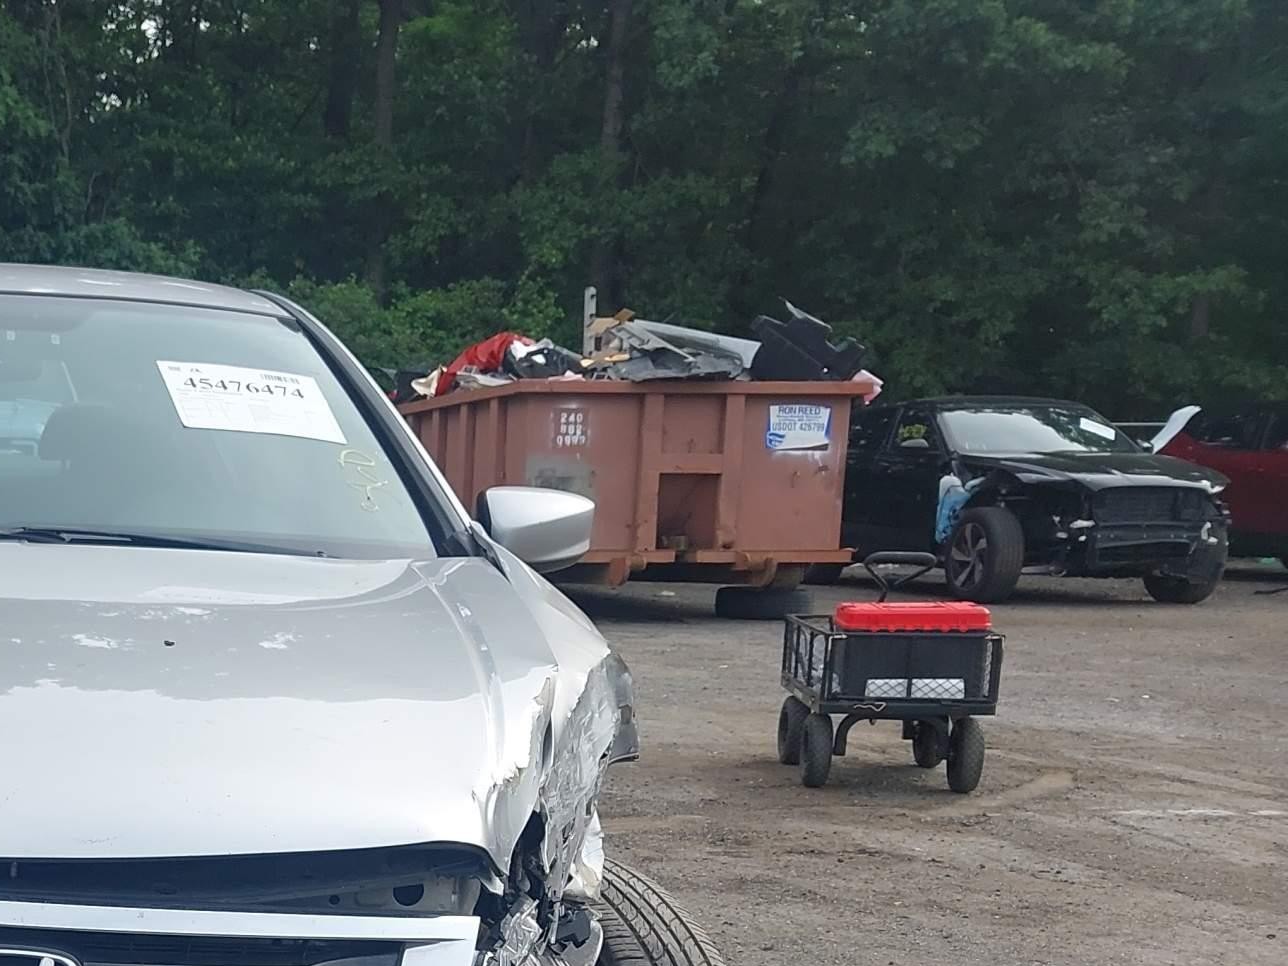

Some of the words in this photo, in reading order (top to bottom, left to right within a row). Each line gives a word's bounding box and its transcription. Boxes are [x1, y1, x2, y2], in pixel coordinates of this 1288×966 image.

[183, 377, 304, 398] 45476474
[778, 406, 797, 415] RON
[798, 406, 821, 415] REED
[772, 422, 797, 431] USDOT
